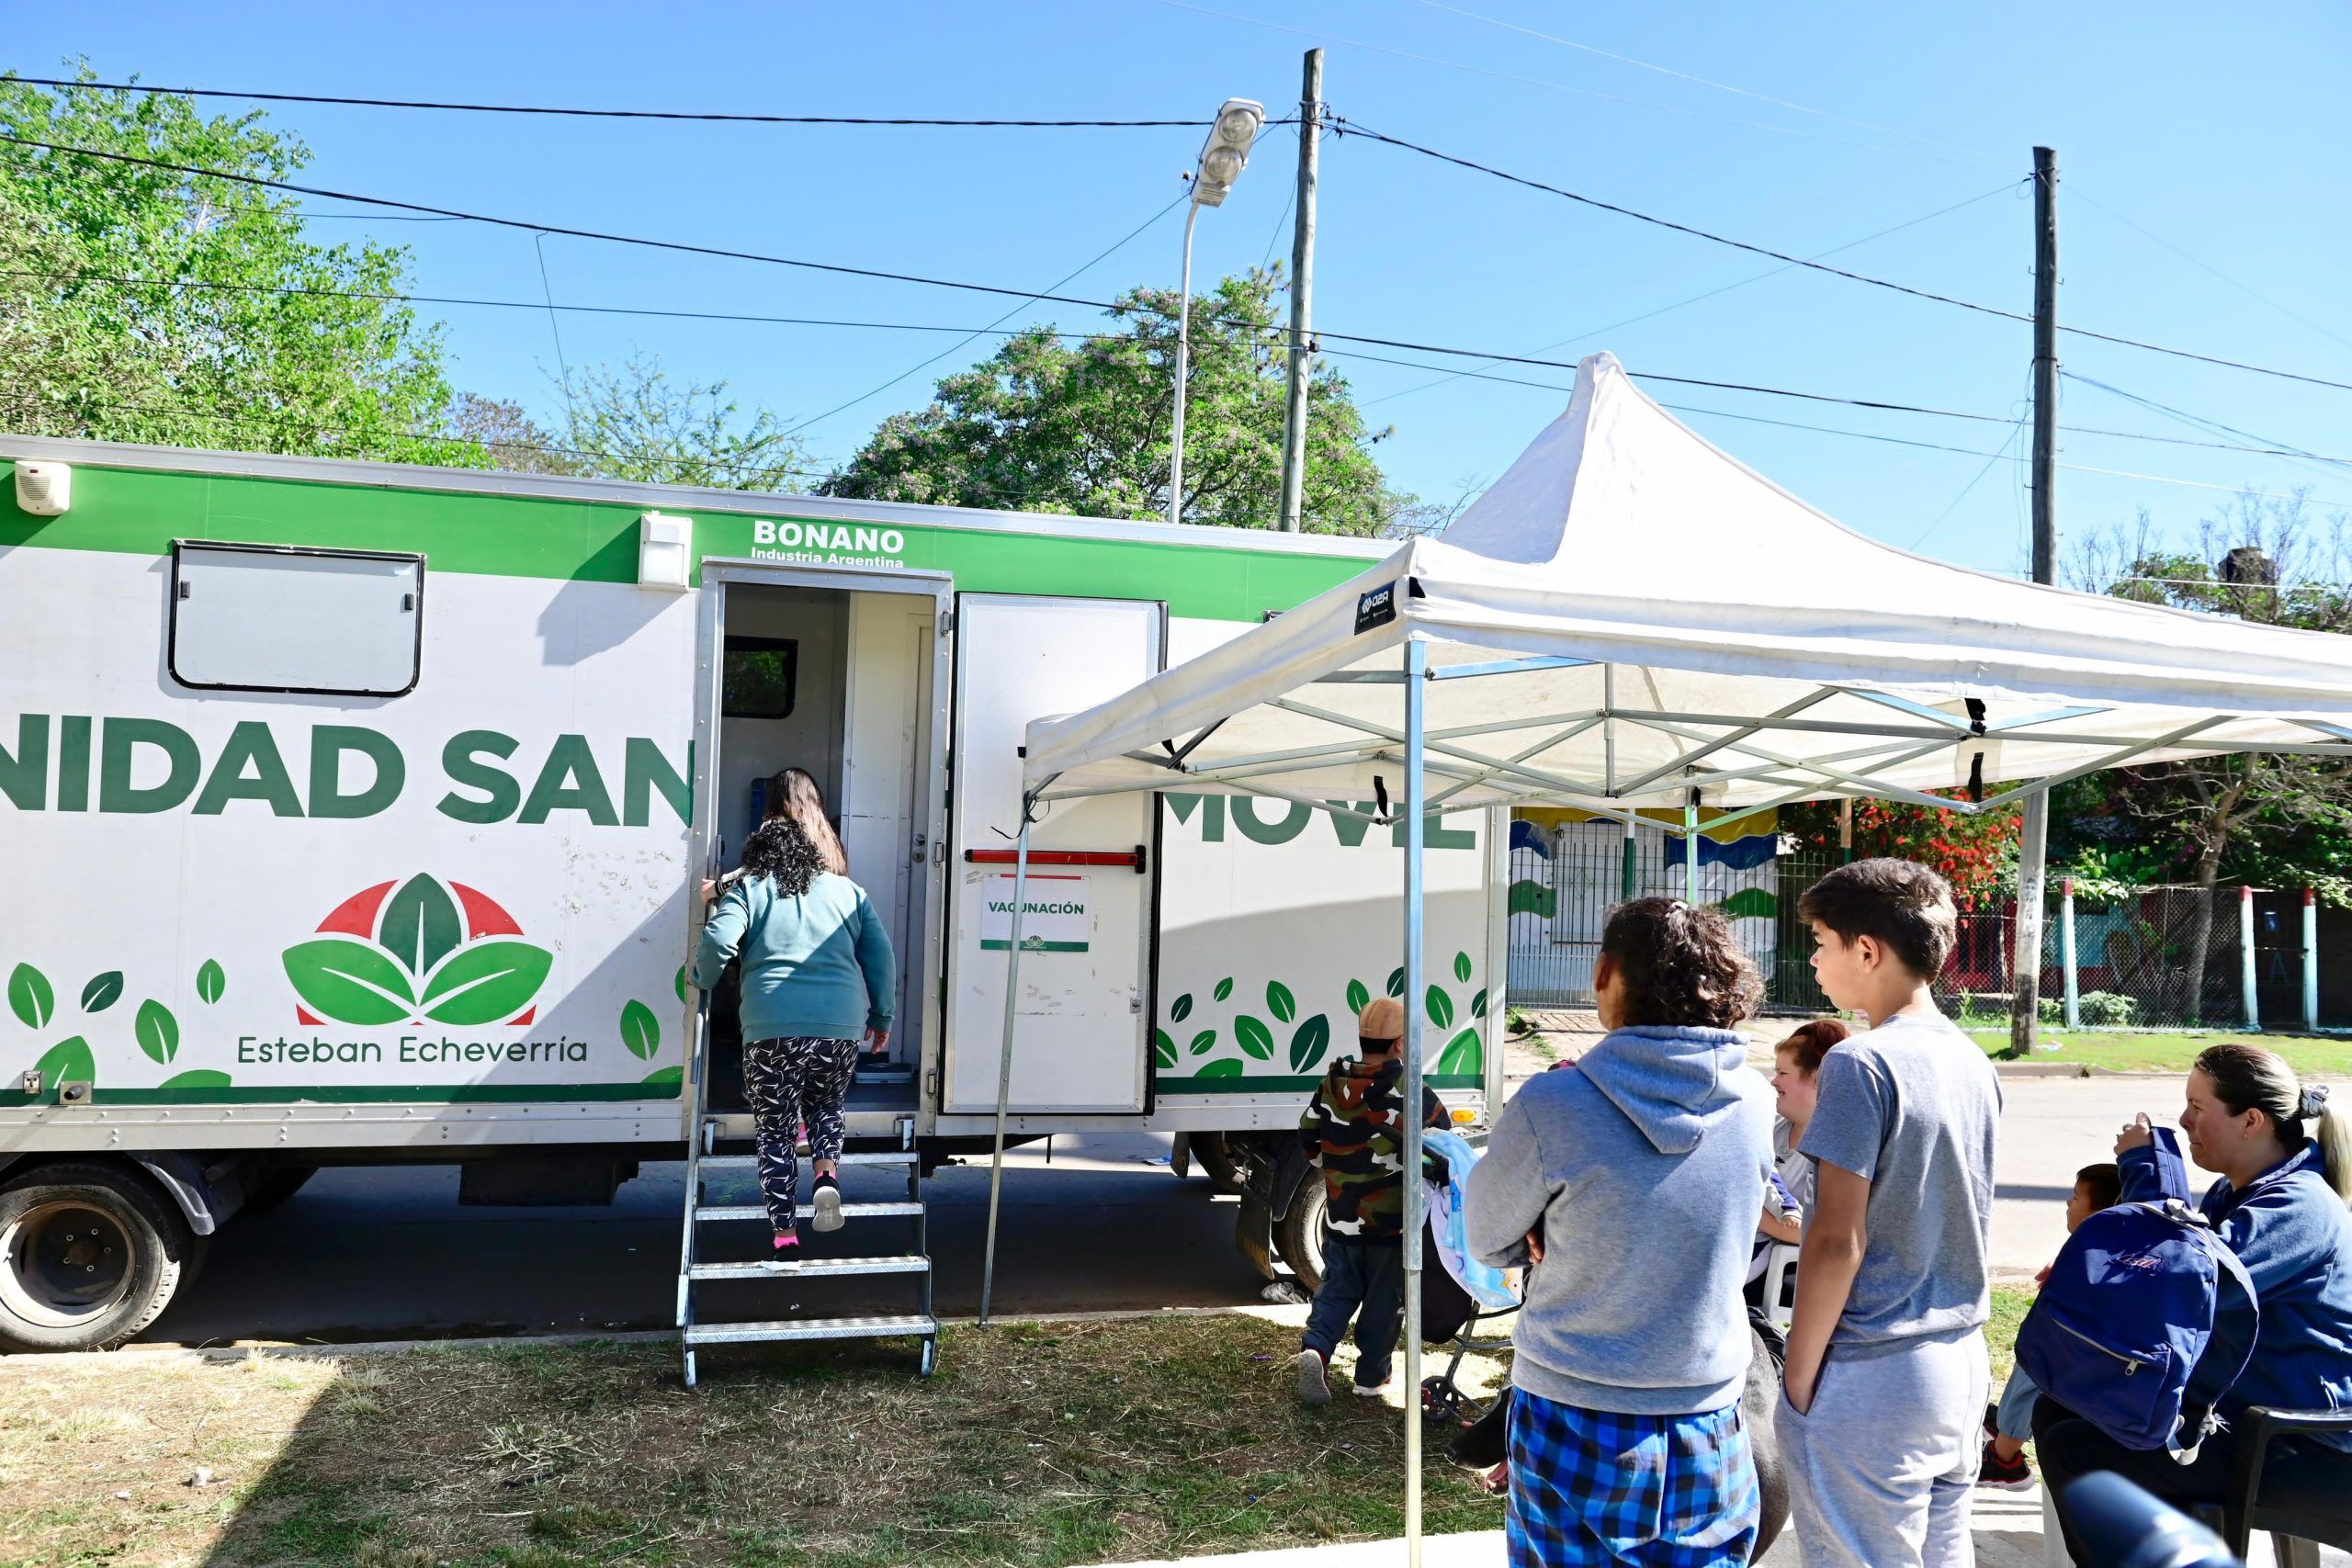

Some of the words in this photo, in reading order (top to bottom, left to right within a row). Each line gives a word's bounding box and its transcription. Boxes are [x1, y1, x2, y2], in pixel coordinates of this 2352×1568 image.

[753, 520, 904, 553] BONANO
[751, 547, 822, 564] Industria
[827, 552, 904, 569] Argentina
[237, 1036, 381, 1064] Esteban
[400, 1035, 588, 1063] Echeverría
